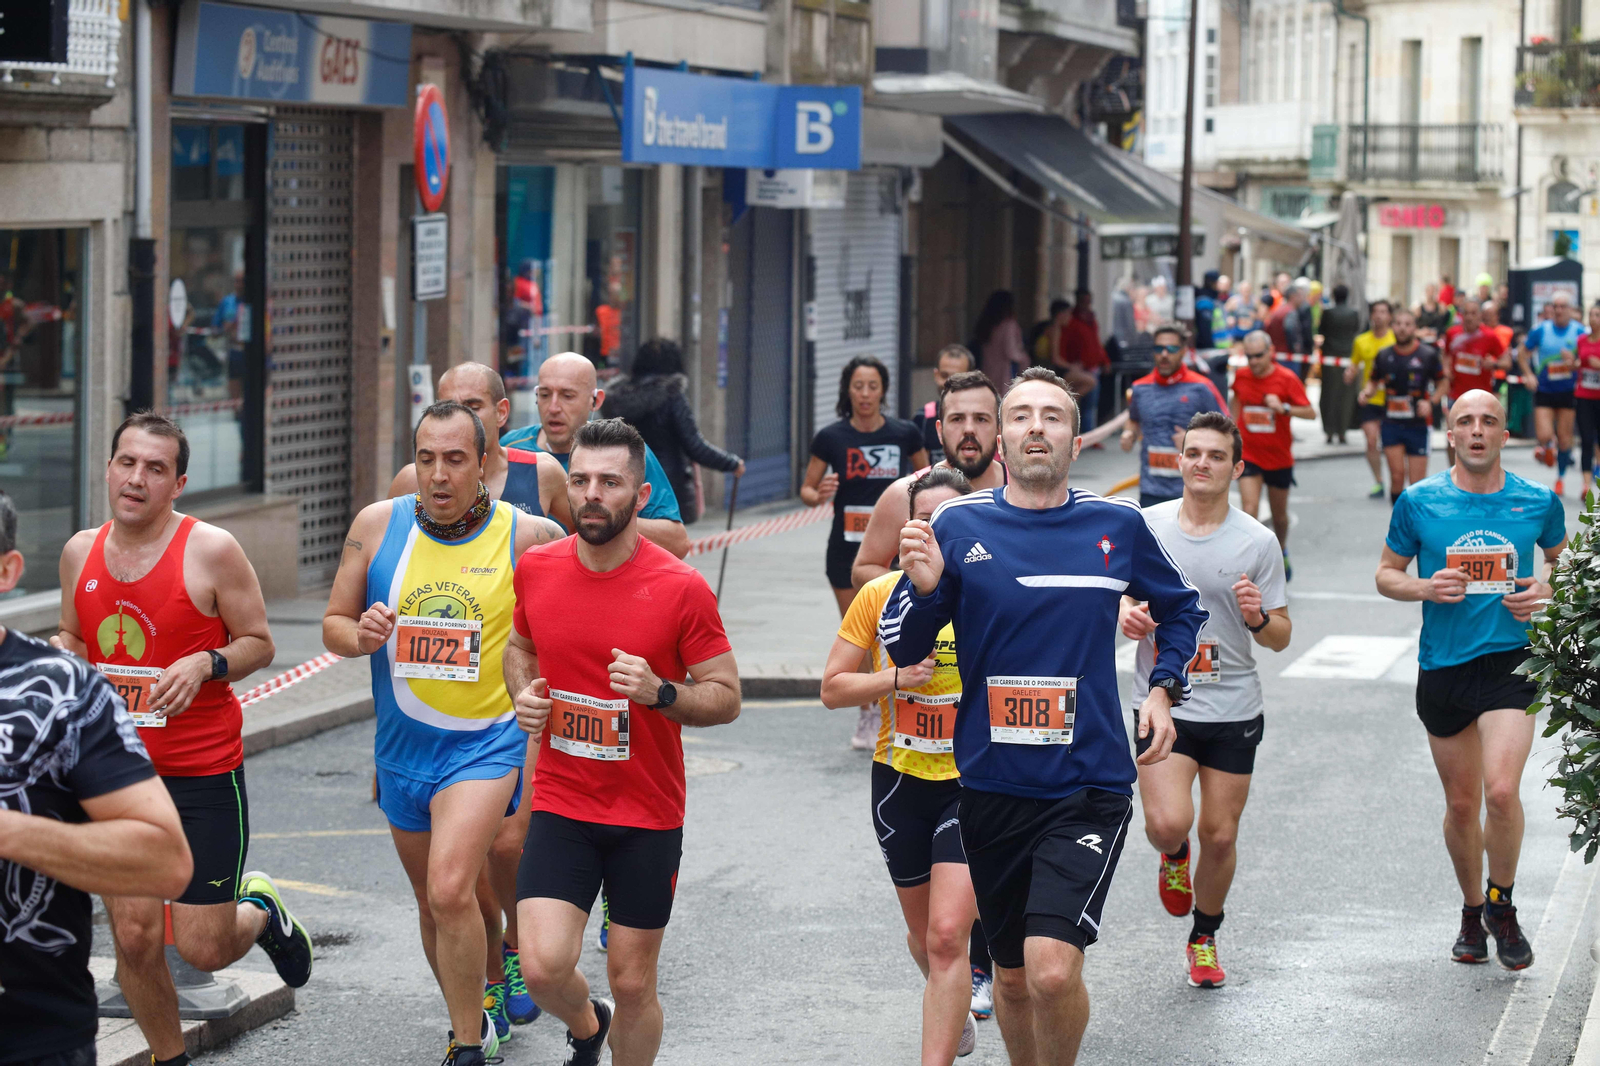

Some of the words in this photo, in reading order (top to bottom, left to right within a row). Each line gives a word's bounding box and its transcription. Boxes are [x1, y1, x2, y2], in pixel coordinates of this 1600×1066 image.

[320, 37, 360, 85] GAES
[795, 101, 835, 154] B
[1484, 530, 1508, 544] CANGAS
[964, 553, 992, 564] adidas
[469, 566, 498, 574] REDONET
[400, 583, 433, 616] TLETAS
[409, 619, 431, 627] CARREIRA
[421, 629, 449, 637] BOUZADA
[409, 636, 459, 665] 1022
[560, 693, 581, 703] CARREIRA
[1012, 689, 1041, 697] GAELETE
[569, 704, 598, 716] IVANPECO
[921, 705, 939, 713] MARGA
[1005, 697, 1049, 727] 308
[562, 711, 603, 745] 300
[916, 711, 943, 739] 911
